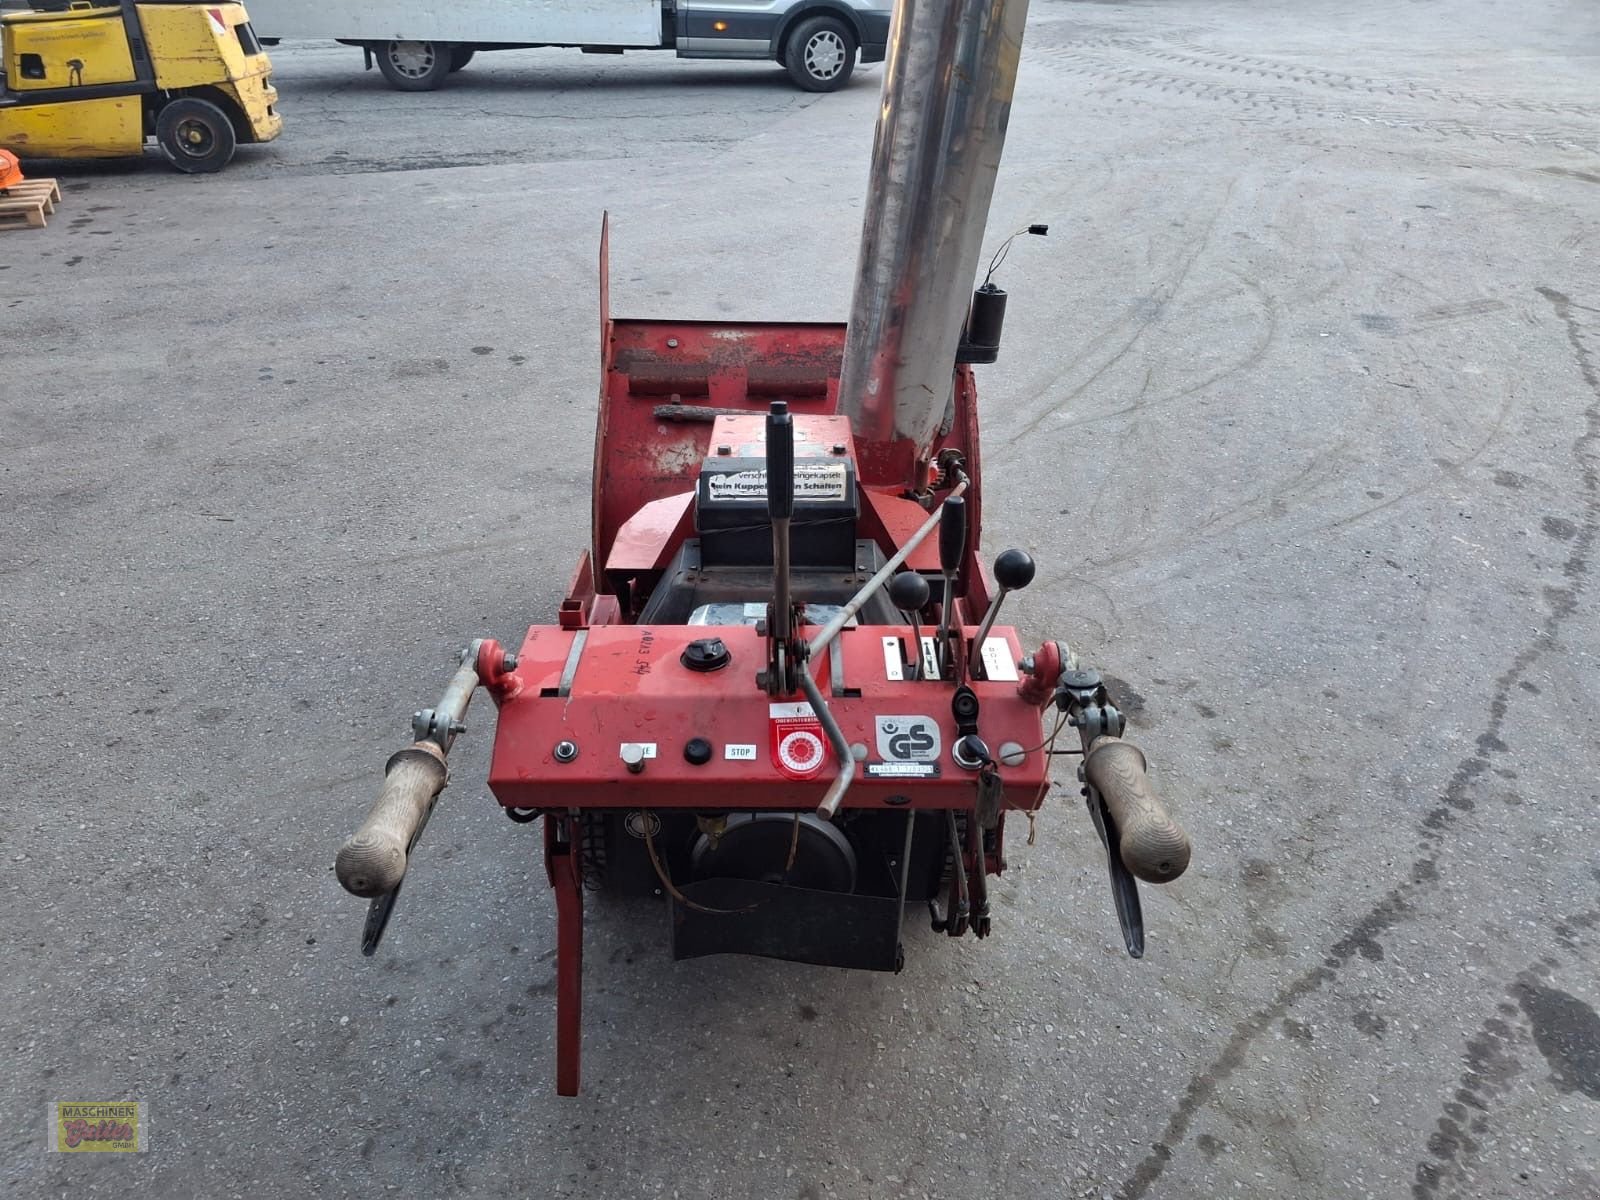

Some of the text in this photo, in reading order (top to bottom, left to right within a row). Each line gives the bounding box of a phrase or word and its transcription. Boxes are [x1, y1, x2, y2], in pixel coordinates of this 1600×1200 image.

[734, 482, 768, 491] Kuppel
[803, 482, 842, 490] Schalten
[889, 724, 934, 759] GS
[731, 748, 751, 756] STOP
